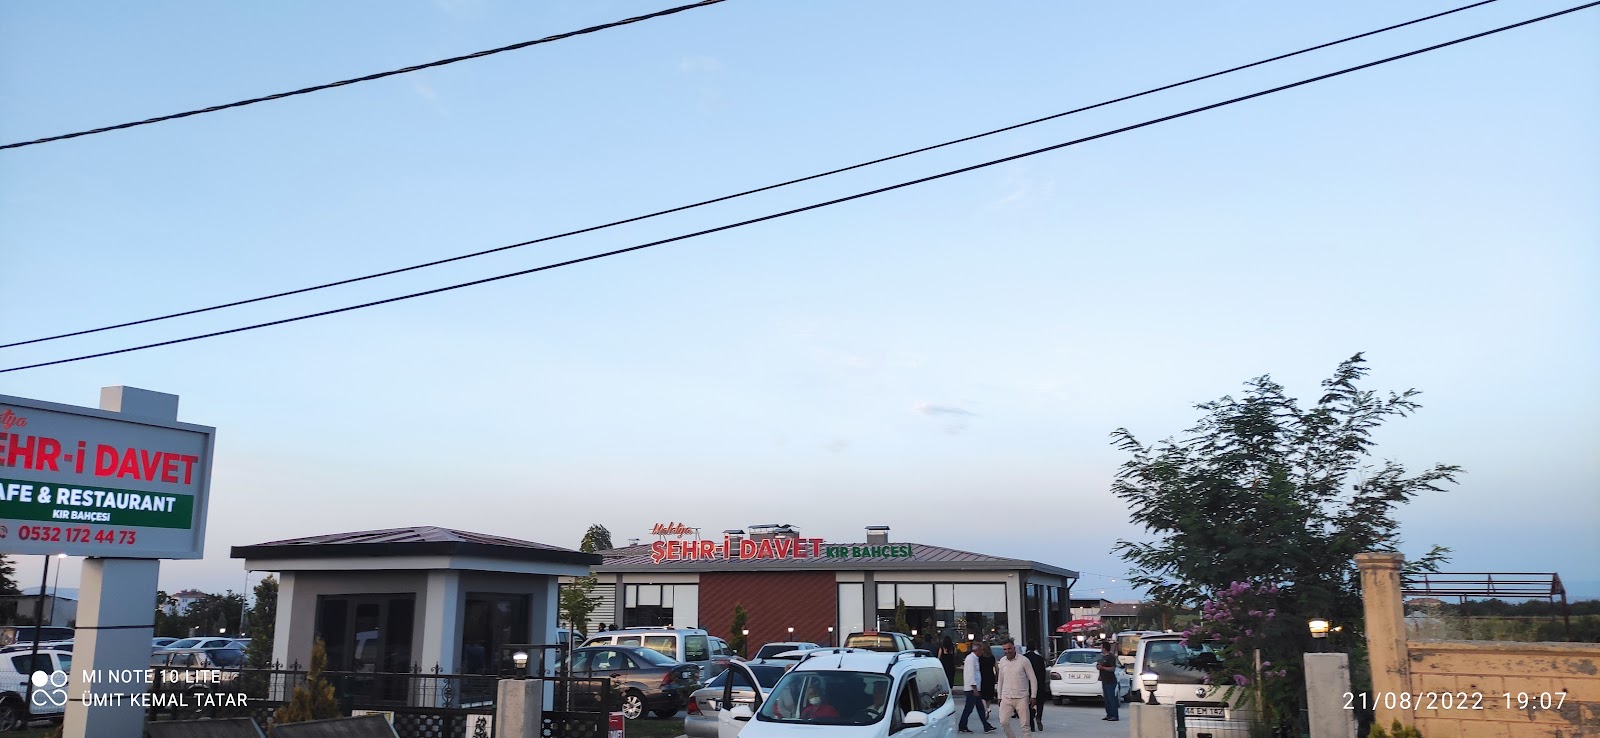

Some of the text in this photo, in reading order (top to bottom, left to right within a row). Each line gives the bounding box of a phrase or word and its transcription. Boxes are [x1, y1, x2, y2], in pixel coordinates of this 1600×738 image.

[0, 408, 27, 429] tya
[94, 443, 199, 485] DAVET
[37, 486, 52, 504] &
[56, 487, 176, 513] RESTAURANT
[52, 509, 70, 519] KIR
[18, 525, 136, 545] 0532 172 44 73
[739, 537, 824, 560] DAVET
[826, 546, 849, 558] KIR
